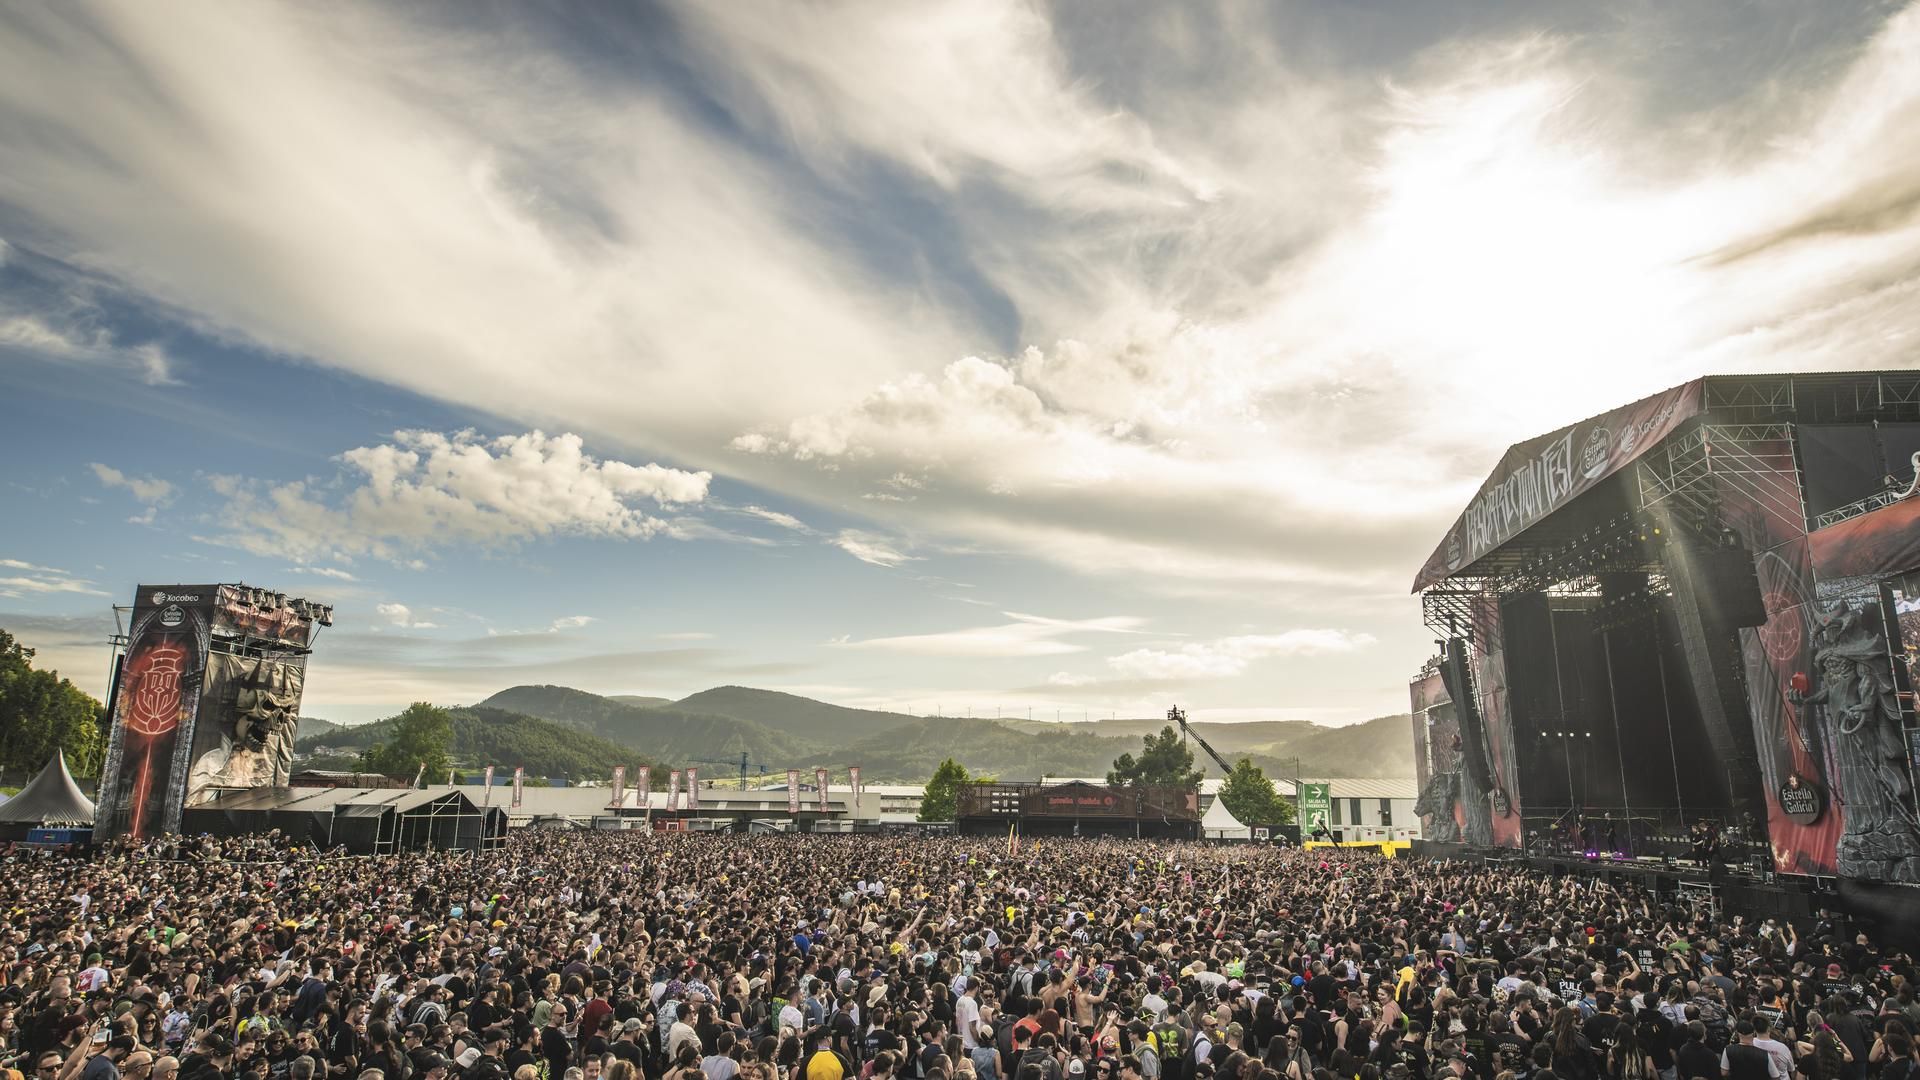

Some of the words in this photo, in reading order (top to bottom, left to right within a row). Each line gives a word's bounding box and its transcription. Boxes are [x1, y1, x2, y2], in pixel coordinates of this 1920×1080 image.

[1540, 427, 1577, 513] FEST
[1782, 788, 1813, 800] Estrella
[1787, 801, 1814, 814] Galicia
